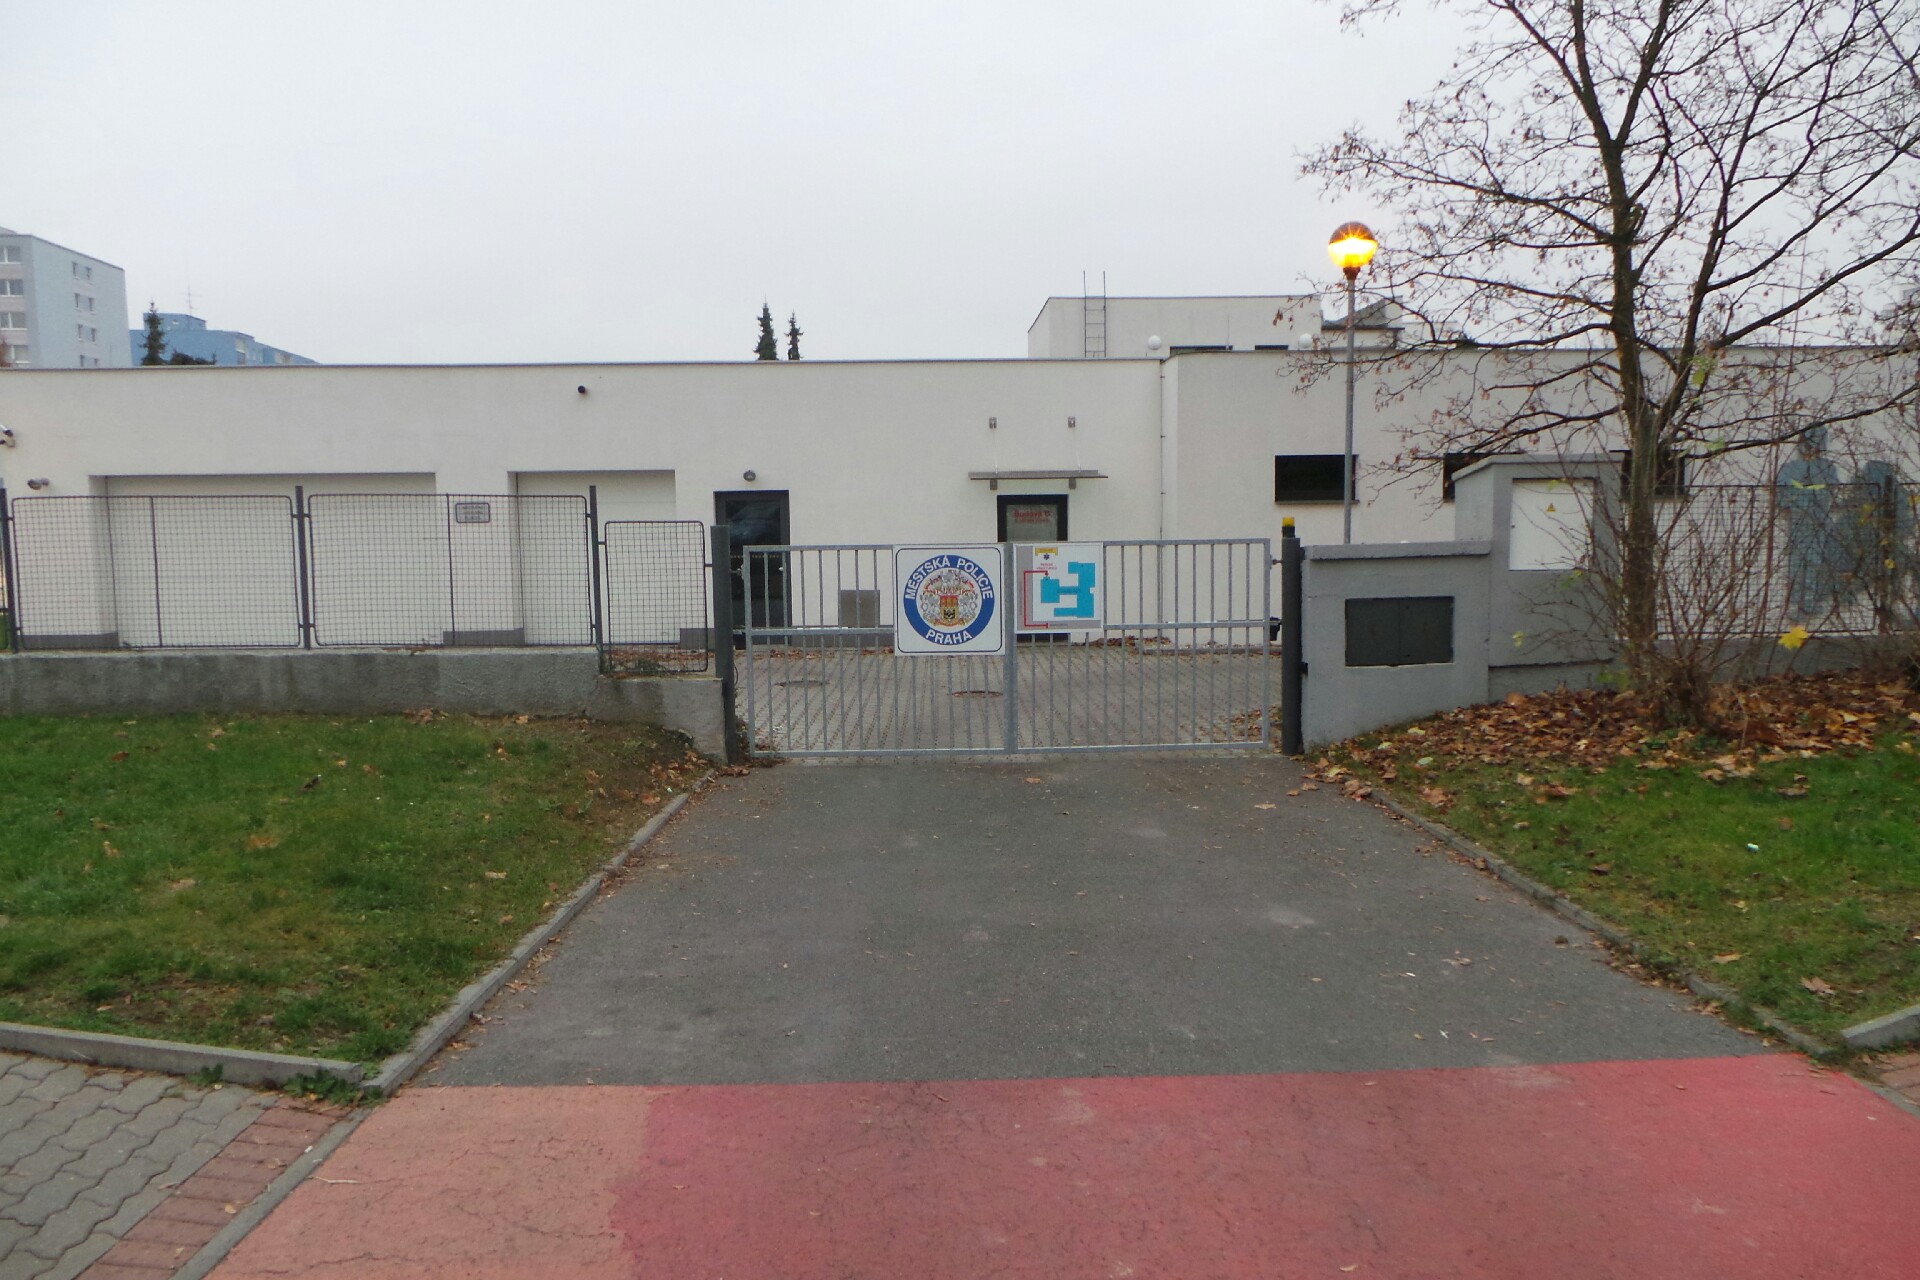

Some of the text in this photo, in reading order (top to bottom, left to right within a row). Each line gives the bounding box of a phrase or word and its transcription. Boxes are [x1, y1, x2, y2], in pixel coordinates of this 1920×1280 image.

[905, 555, 951, 599] MĚSTSKÁ
[956, 558, 993, 599] POLICIE
[926, 629, 973, 645] PRAHA
